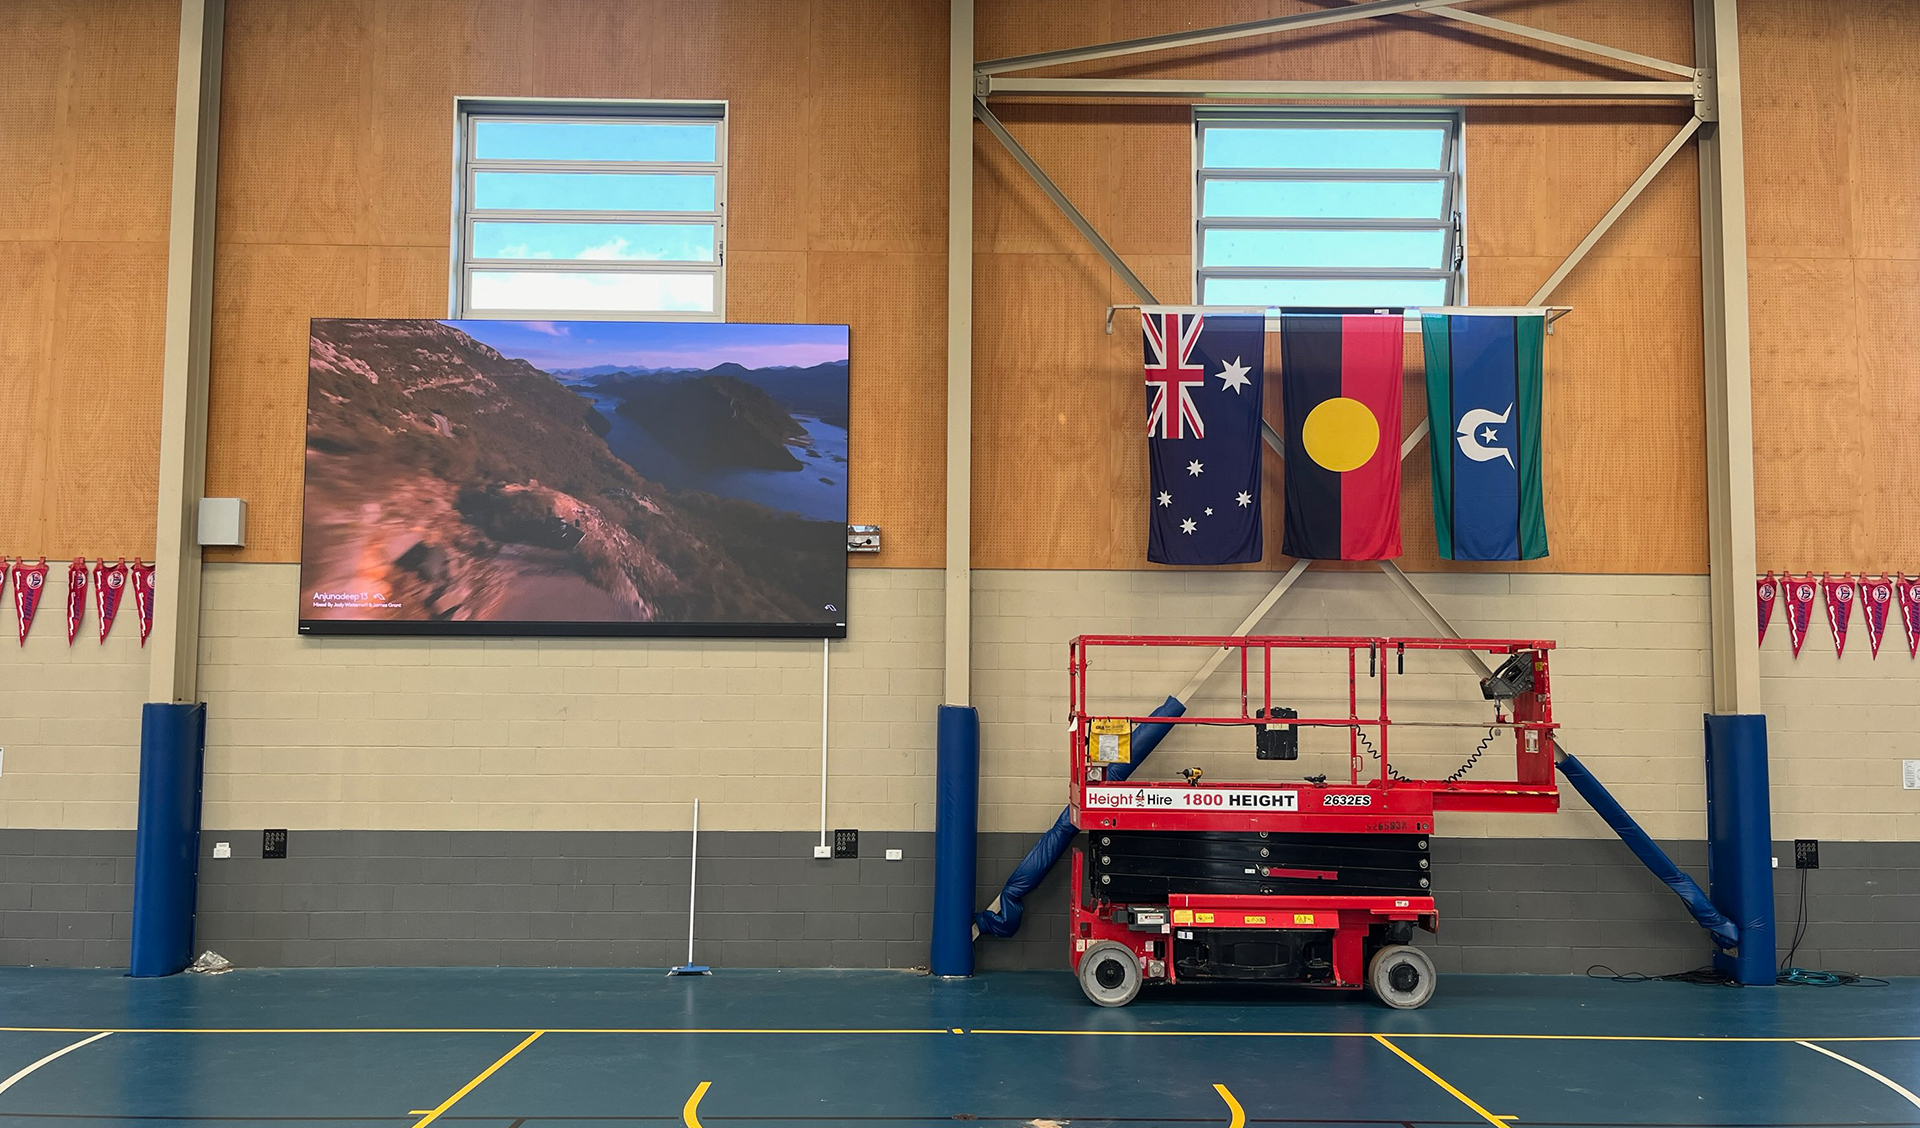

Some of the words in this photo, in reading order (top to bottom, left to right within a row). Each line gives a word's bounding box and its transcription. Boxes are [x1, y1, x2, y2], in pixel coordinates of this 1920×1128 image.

[1088, 793, 1133, 808] Height
[1147, 794, 1173, 805] Hire
[1183, 793, 1223, 806] 1800
[1229, 794, 1294, 807] HEIGHT
[1323, 795, 1371, 806] 2632ES
